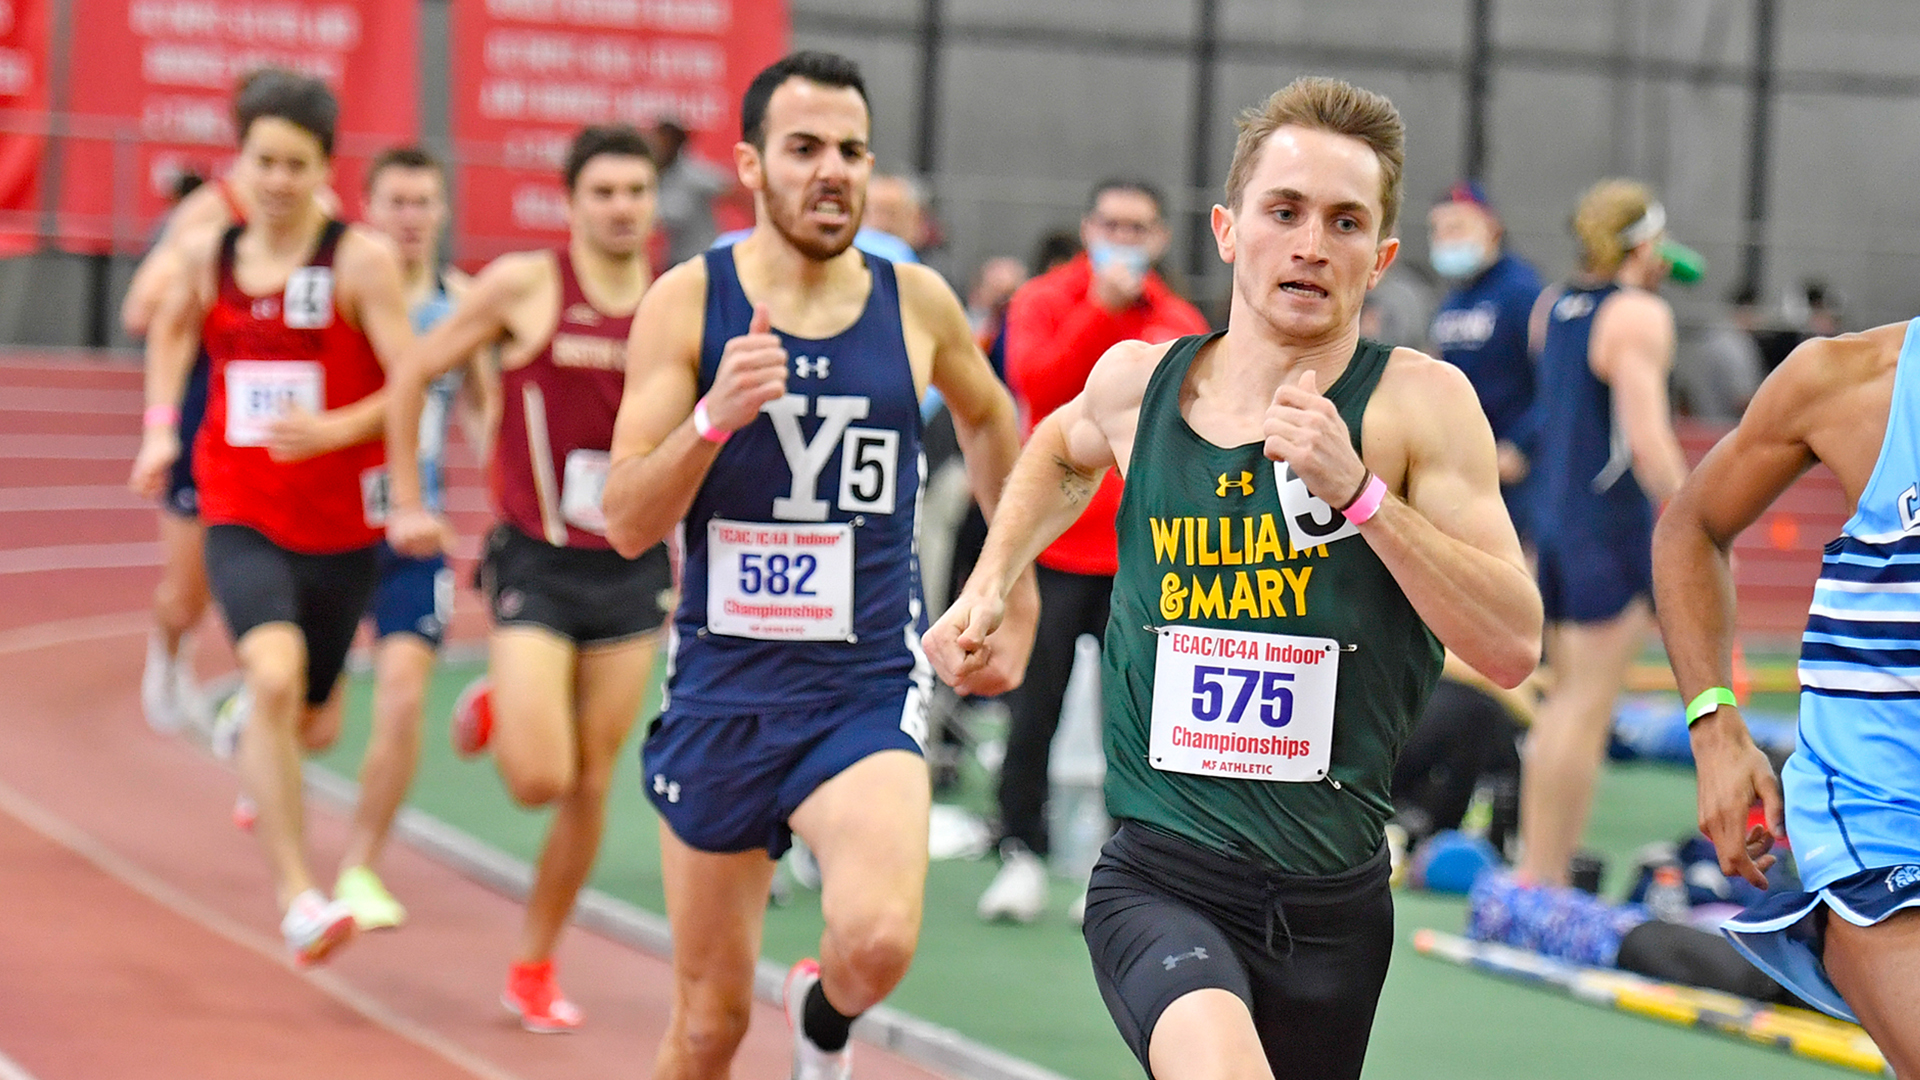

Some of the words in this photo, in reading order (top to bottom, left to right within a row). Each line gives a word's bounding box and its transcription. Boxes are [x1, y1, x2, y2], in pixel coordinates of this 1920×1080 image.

[759, 393, 870, 521] Y
[851, 437, 885, 502] 5
[740, 553, 817, 595] 582
[724, 600, 834, 620] Championships
[1172, 633, 1259, 660] ECAC/IC4A
[1265, 642, 1326, 665] Indoor
[1191, 664, 1296, 729] 575
[1172, 725, 1310, 760] Championships
[1219, 761, 1273, 775] ATHLETIC
